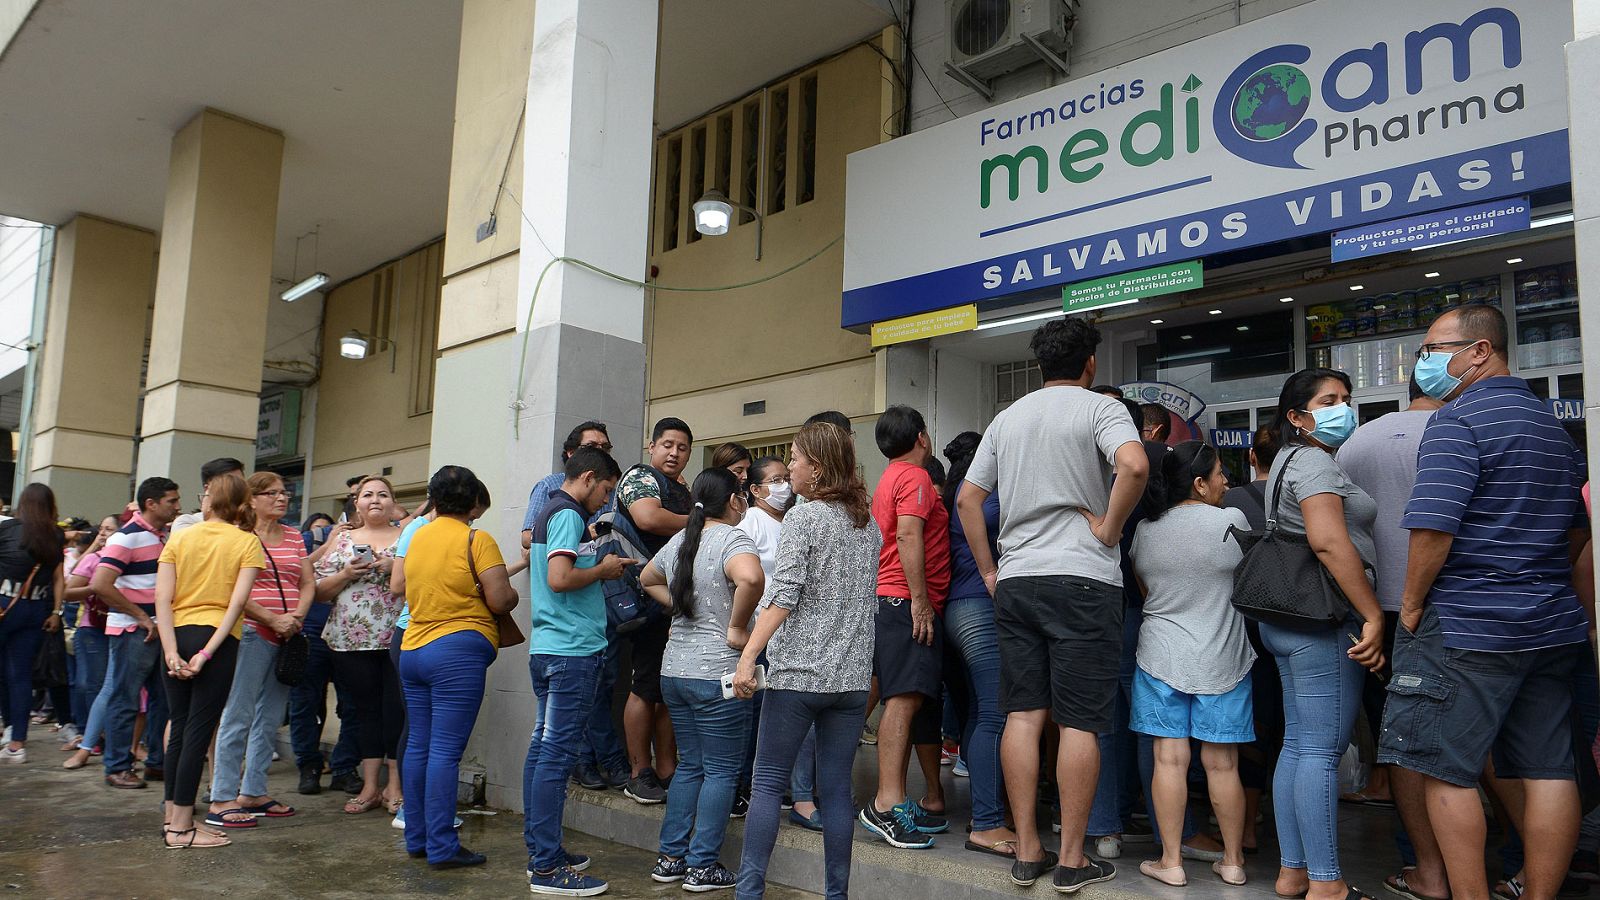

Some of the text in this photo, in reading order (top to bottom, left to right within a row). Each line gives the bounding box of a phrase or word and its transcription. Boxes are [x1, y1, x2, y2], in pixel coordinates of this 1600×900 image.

[980, 78, 1145, 146] Farmacias
[1324, 83, 1525, 158] Pharma
[982, 150, 1525, 290] SALVAMOS VIDAS!
[1334, 205, 1525, 246] Productos para el cuidado
[1360, 219, 1494, 251] y tu aseo personal
[1069, 293, 1105, 306] precios
[1123, 276, 1194, 294] Distribuidora
[1071, 286, 1103, 297] Somos
[1119, 273, 1167, 287] Farmacia
[1171, 268, 1191, 277] con
[876, 322, 915, 334] Productos
[916, 318, 935, 327] para
[889, 328, 919, 338] cuidado
[1215, 430, 1243, 447] CAJA
